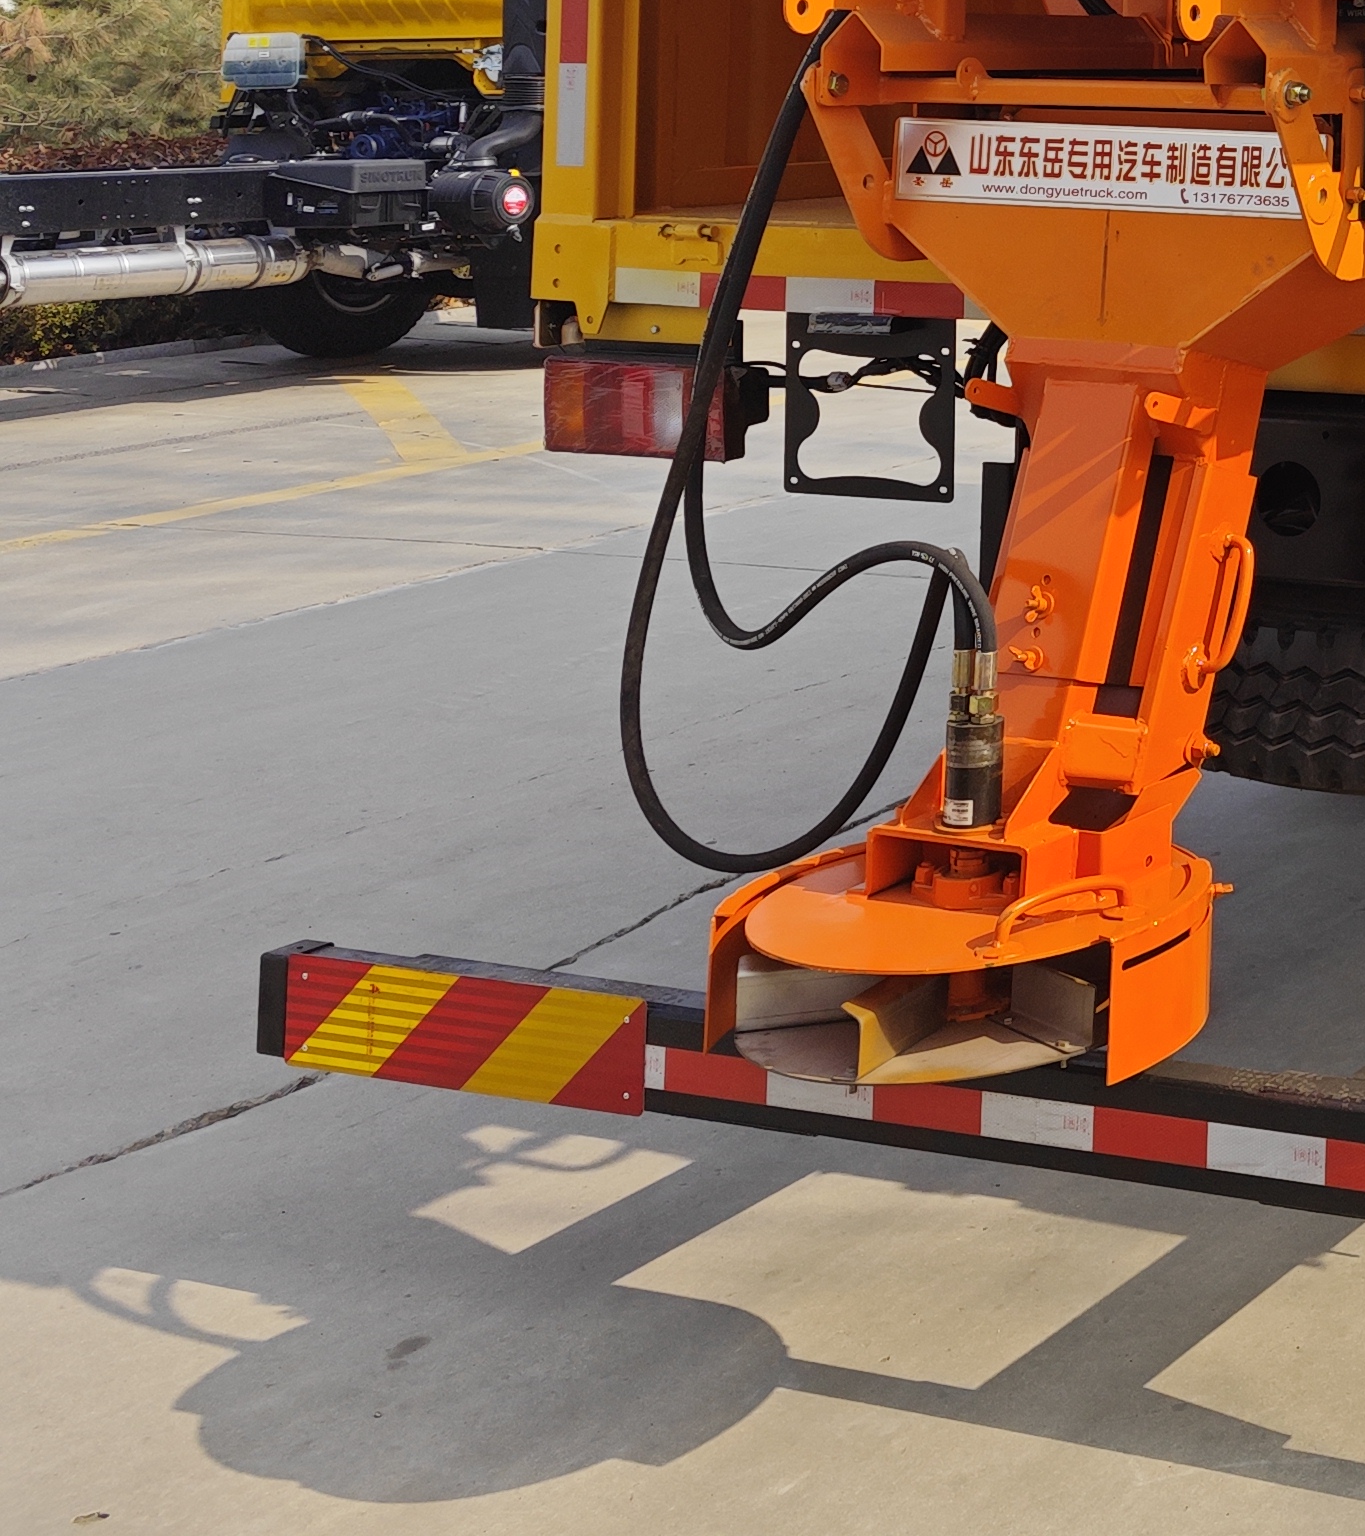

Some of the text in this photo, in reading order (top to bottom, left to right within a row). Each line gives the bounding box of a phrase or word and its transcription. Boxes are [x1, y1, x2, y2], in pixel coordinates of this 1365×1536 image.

[968, 132, 1293, 189] 山东东岳专用汽车制造有限公
[359, 169, 425, 184] SINOTRUK
[982, 182, 1148, 201] www.dongyuetruck.com
[1193, 192, 1290, 208] 13176773635
